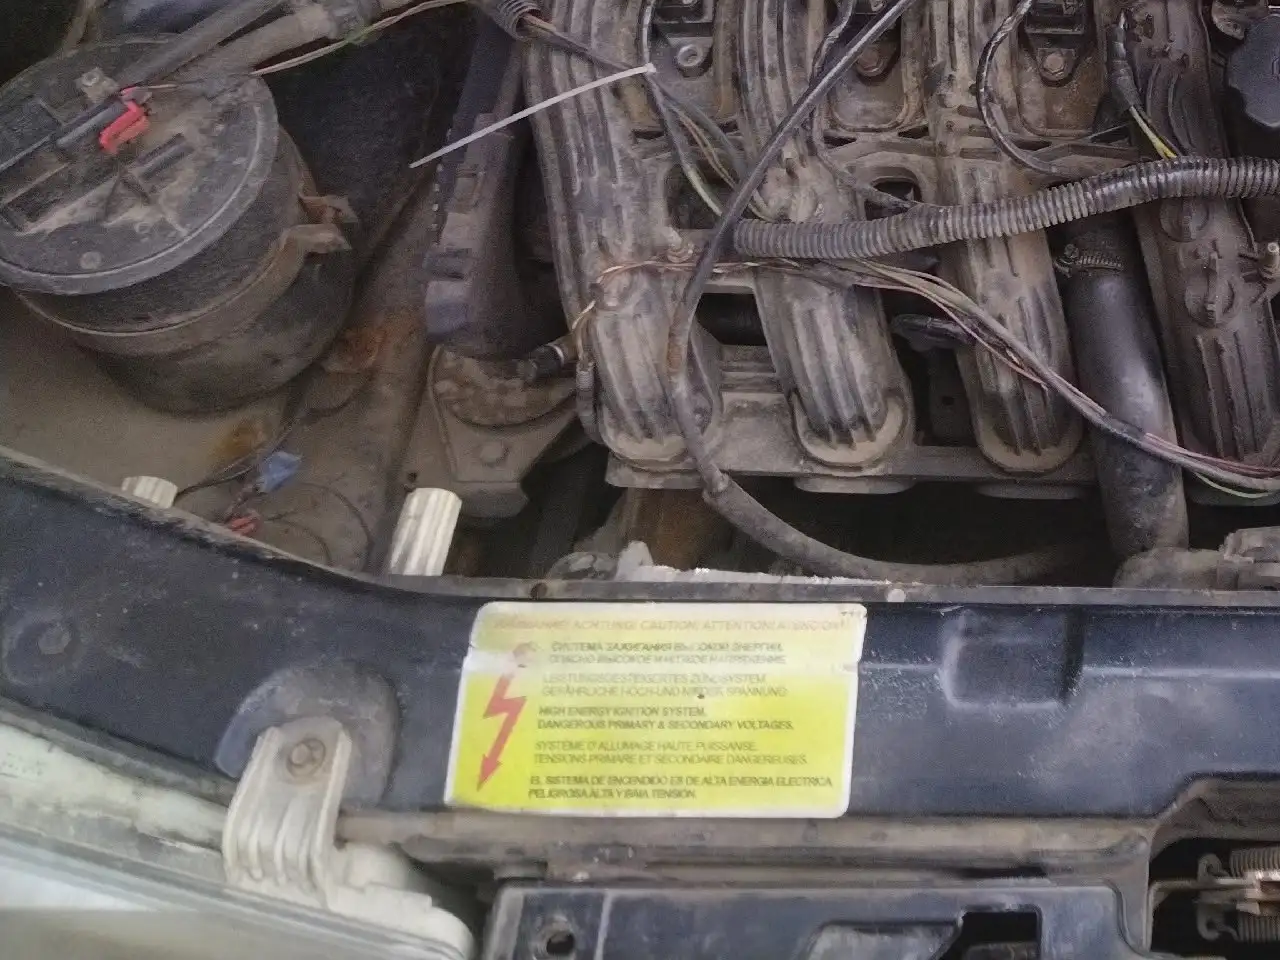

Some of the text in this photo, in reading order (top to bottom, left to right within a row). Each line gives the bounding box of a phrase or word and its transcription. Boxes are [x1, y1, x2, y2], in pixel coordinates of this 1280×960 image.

[539, 706, 566, 716] HIGH
[568, 706, 613, 716] ENERGY
[613, 706, 658, 716] IGNITION
[537, 719, 605, 729] DANGEROUS
[608, 719, 653, 729] PRIMARY
[667, 719, 731, 729] SECONDARY
